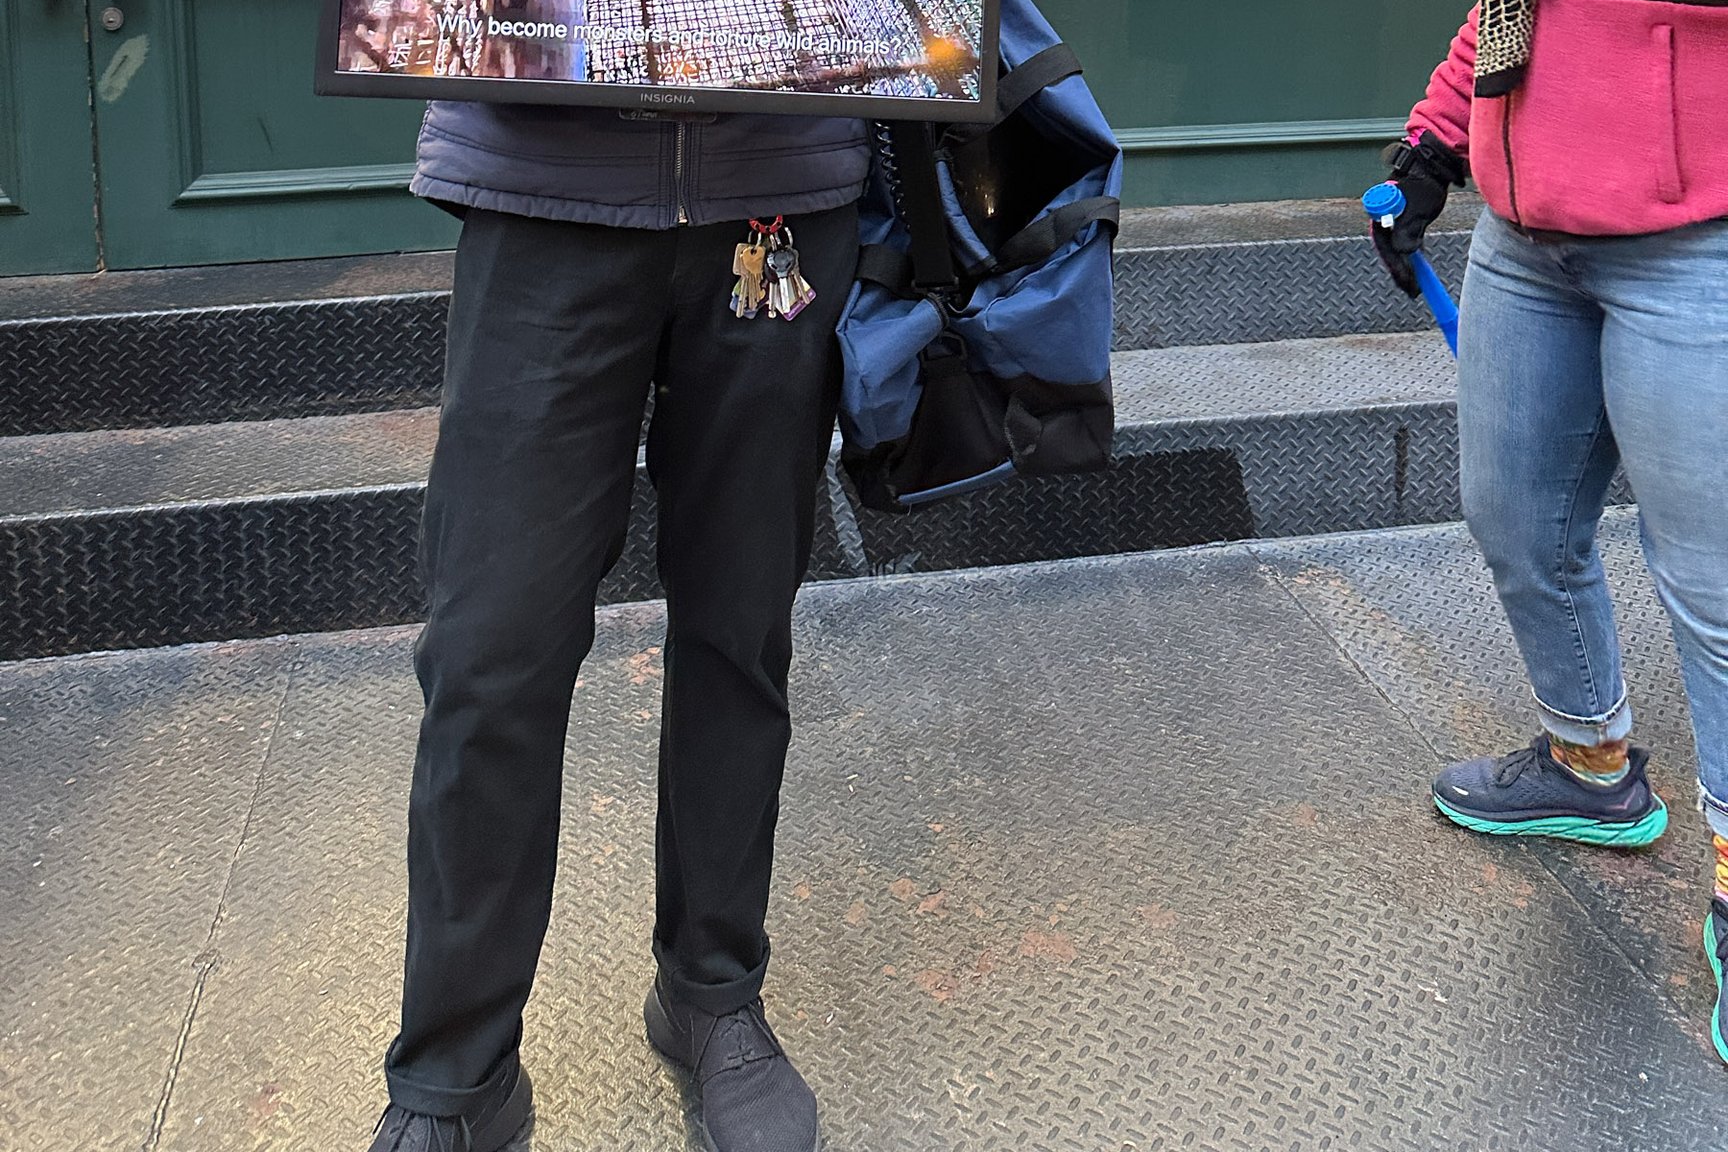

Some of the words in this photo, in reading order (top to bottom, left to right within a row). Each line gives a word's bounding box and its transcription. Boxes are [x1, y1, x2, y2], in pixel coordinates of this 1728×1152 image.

[436, 13, 483, 38] Why
[488, 16, 568, 39] become
[574, 24, 662, 44] monsters
[668, 28, 706, 45] and
[709, 30, 771, 49] torture
[773, 32, 814, 51] wild
[818, 36, 900, 56] animals?
[639, 92, 696, 105] INSIGNIA
